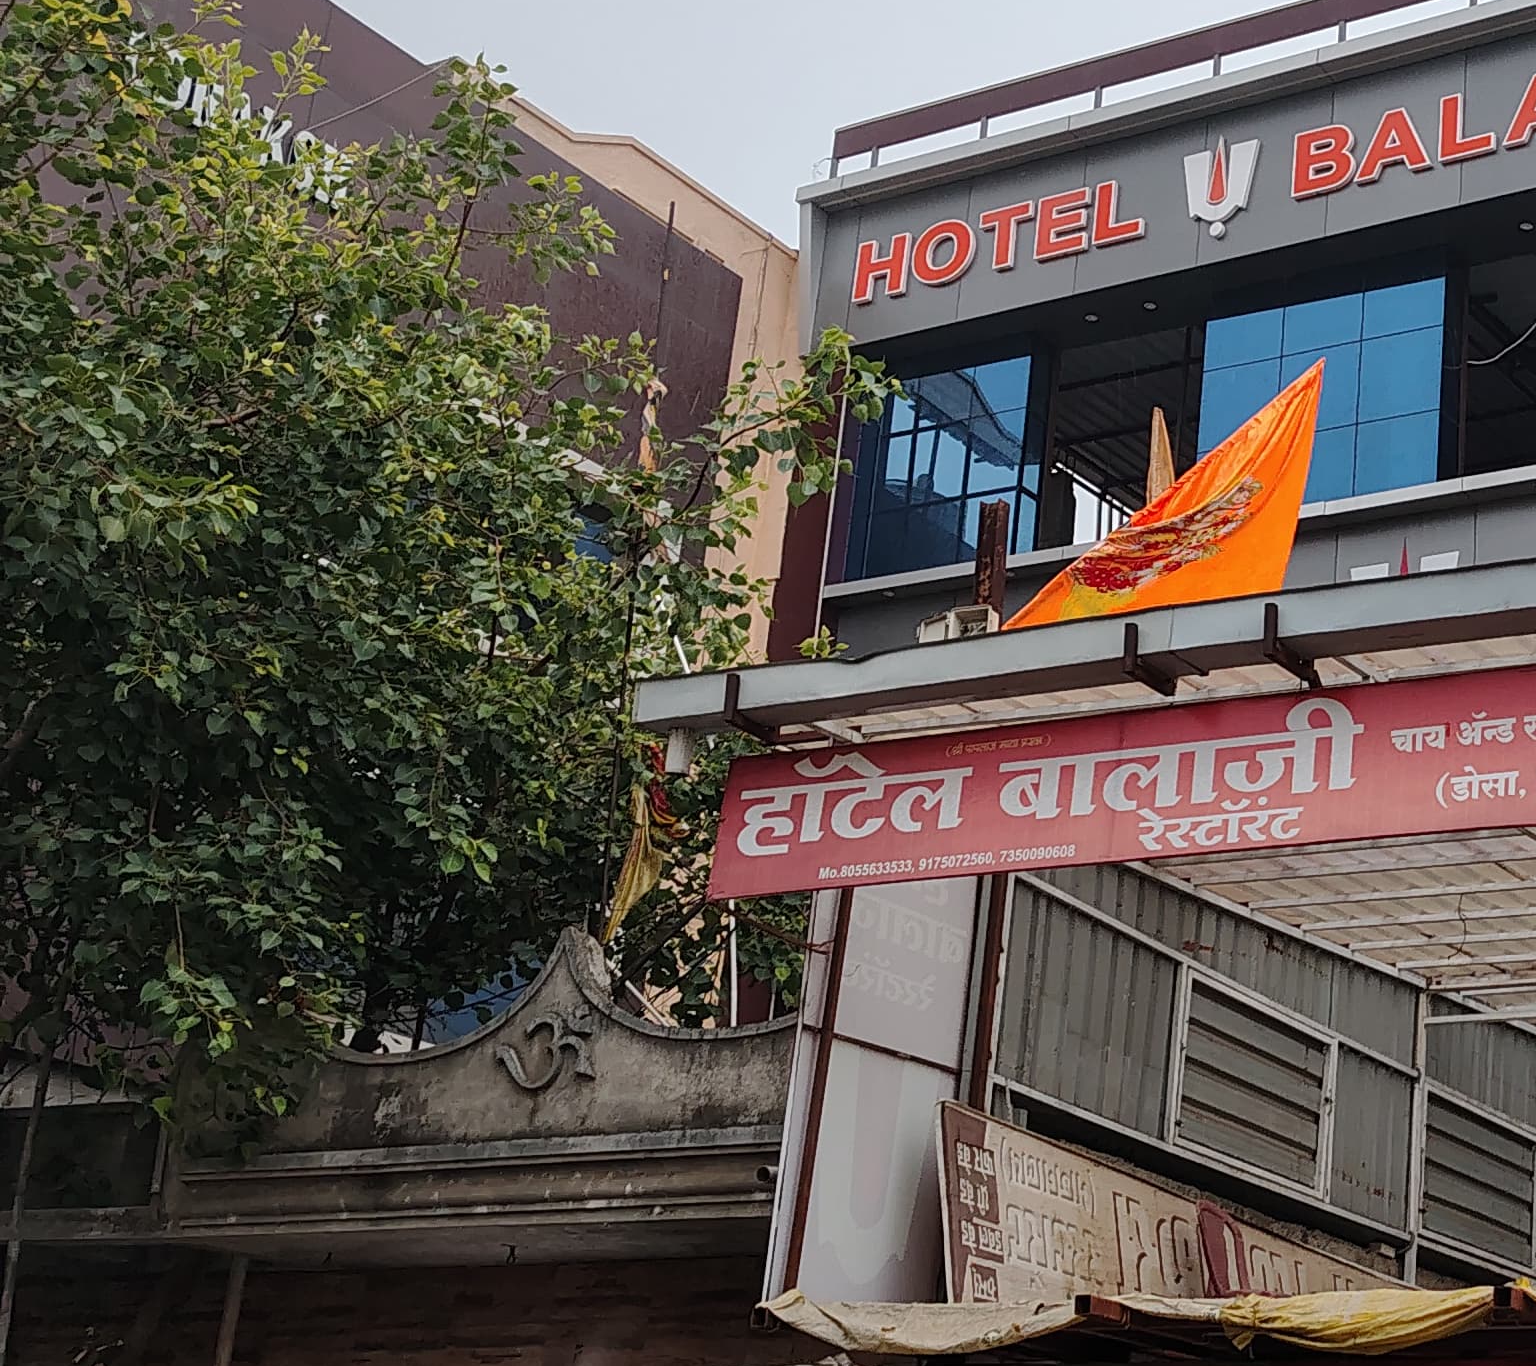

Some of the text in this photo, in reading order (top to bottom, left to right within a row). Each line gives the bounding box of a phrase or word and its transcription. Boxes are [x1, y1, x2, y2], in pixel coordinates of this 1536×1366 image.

[851, 180, 1145, 304] HOTEL
[737, 697, 1364, 857] हॉटेल बालाजी
[1391, 725, 1447, 753] चाय
[1137, 796, 1304, 852] रेस्टॉरंट
